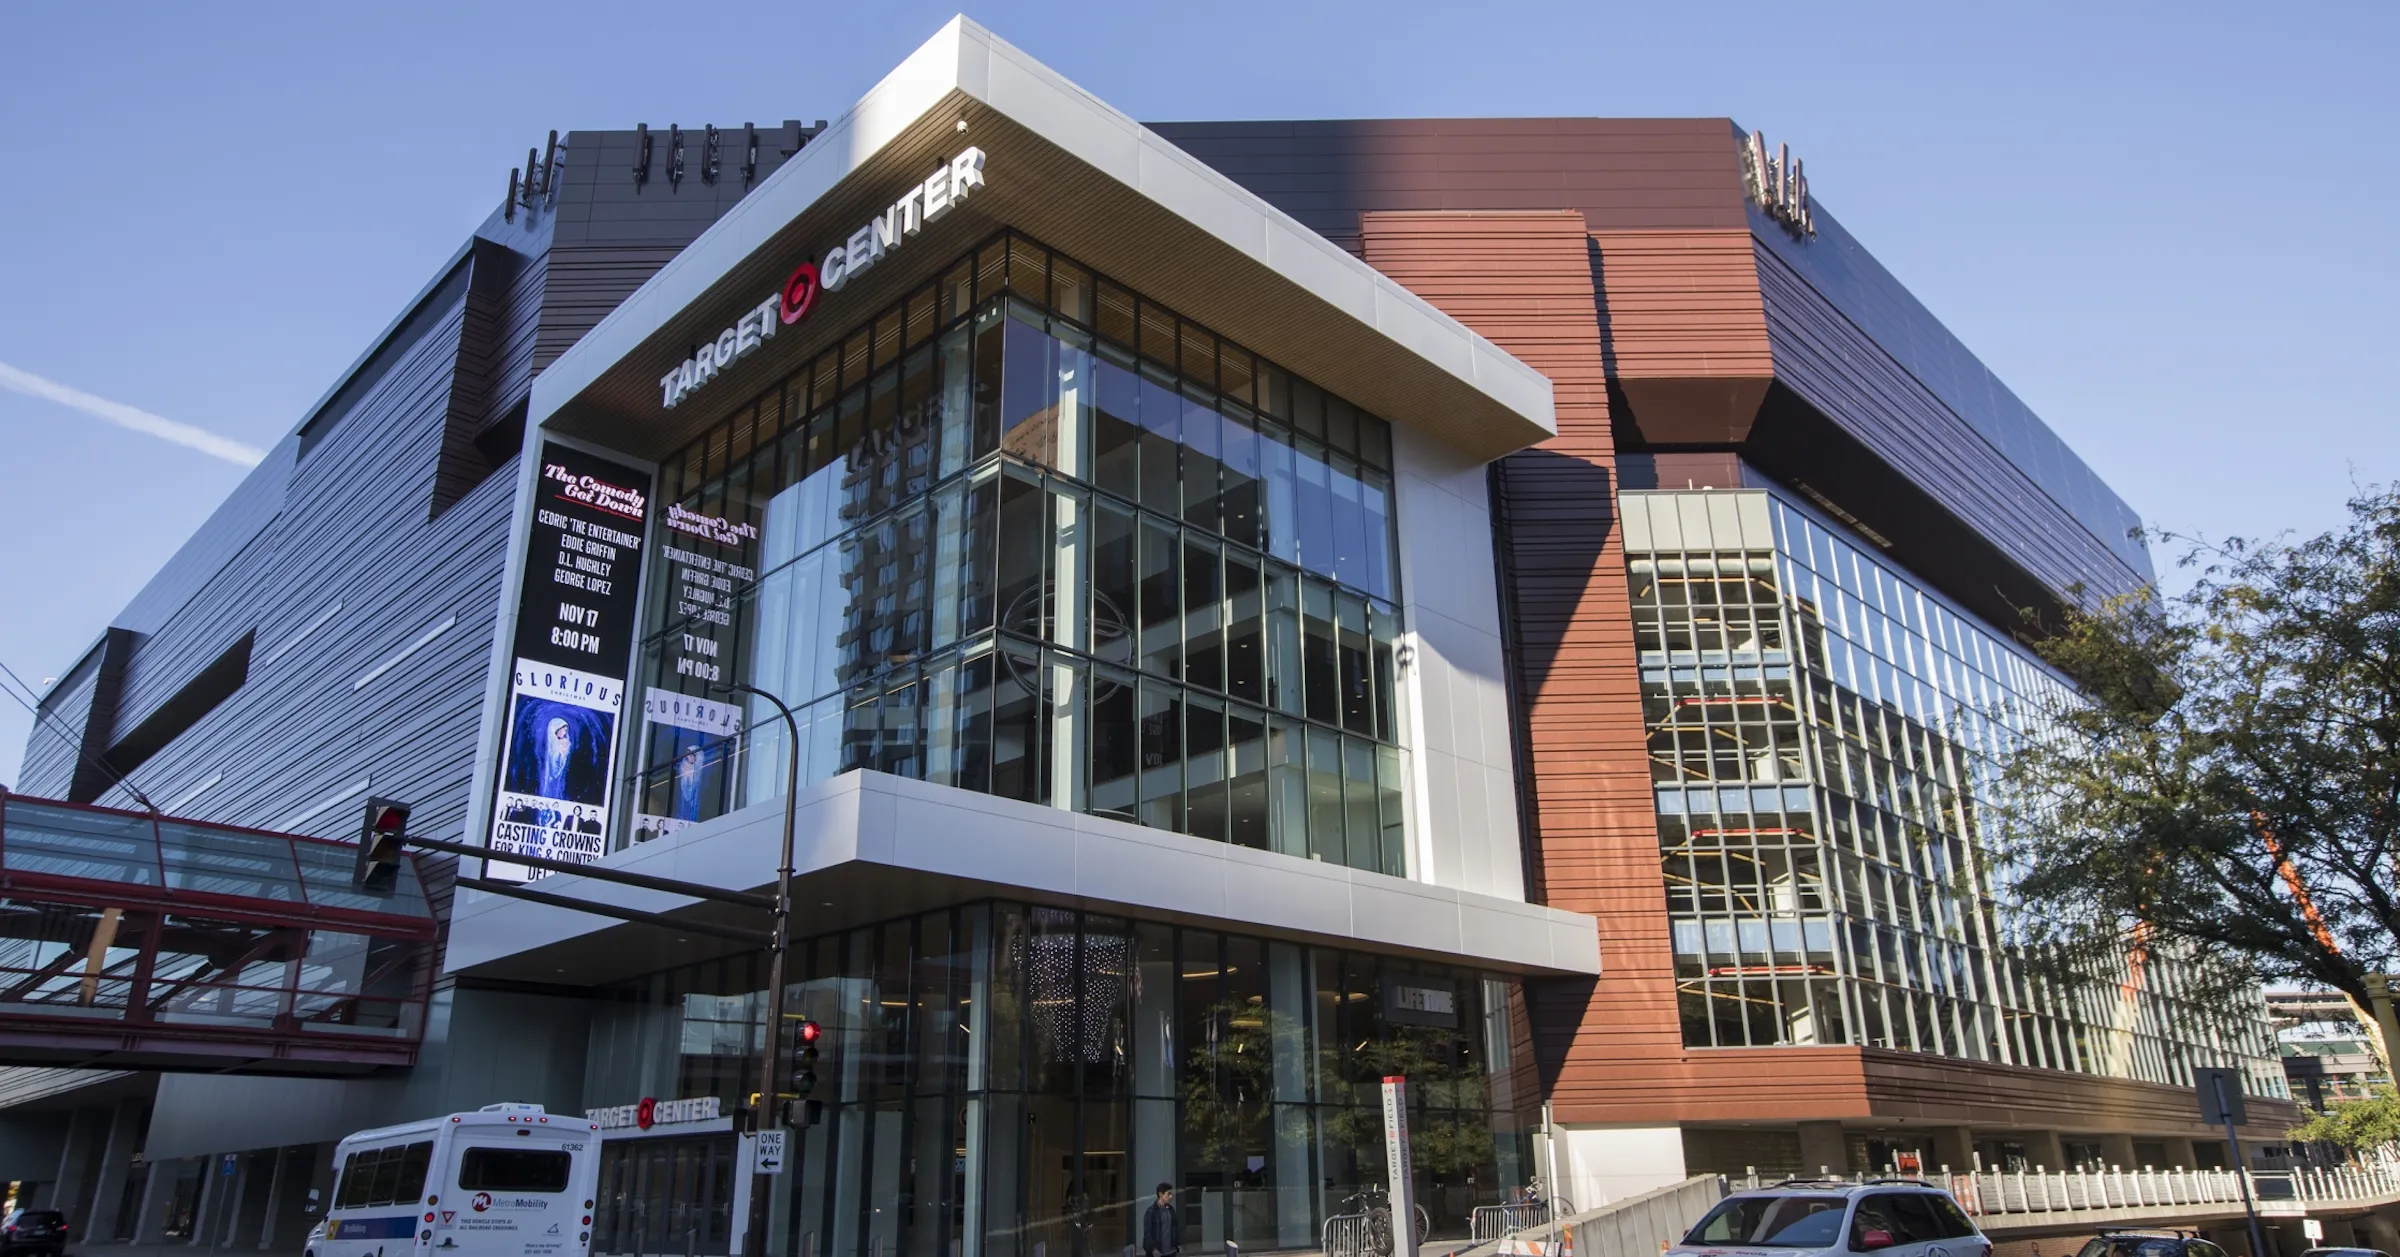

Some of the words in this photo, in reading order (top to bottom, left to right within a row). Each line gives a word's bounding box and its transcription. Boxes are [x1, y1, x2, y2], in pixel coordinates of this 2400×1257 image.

[660, 293, 782, 410] TARGET
[820, 146, 986, 292] CENTER
[544, 464, 577, 484] The
[580, 476, 645, 508] Comedy
[564, 484, 595, 502] Get
[595, 494, 643, 517] Down
[538, 509, 568, 529] CEDRIC
[570, 518, 587, 535] 'THE
[561, 534, 585, 552] EDDIE
[585, 541, 616, 560] GRIFFIN
[558, 551, 573, 567] D.L.
[575, 556, 611, 577] HUGHLEY
[554, 568, 585, 588] GEORGE
[587, 577, 612, 595] LOPEZ
[559, 602, 585, 624] NOV
[586, 610, 599, 628] 17
[551, 626, 579, 649] 8:00
[580, 634, 600, 654] PM
[515, 672, 621, 706] GLORIOUS
[495, 841, 513, 853] FOR
[519, 844, 541, 858] KING
[545, 848, 553, 859] &
[497, 823, 547, 845] CASTING
[552, 831, 601, 853] CROWNS
[585, 1104, 638, 1128] TARGET
[652, 1096, 720, 1124] CENTER
[561, 1143, 584, 1152] 61362
[759, 1145, 782, 1156] WAY
[761, 1133, 781, 1144] ONE
